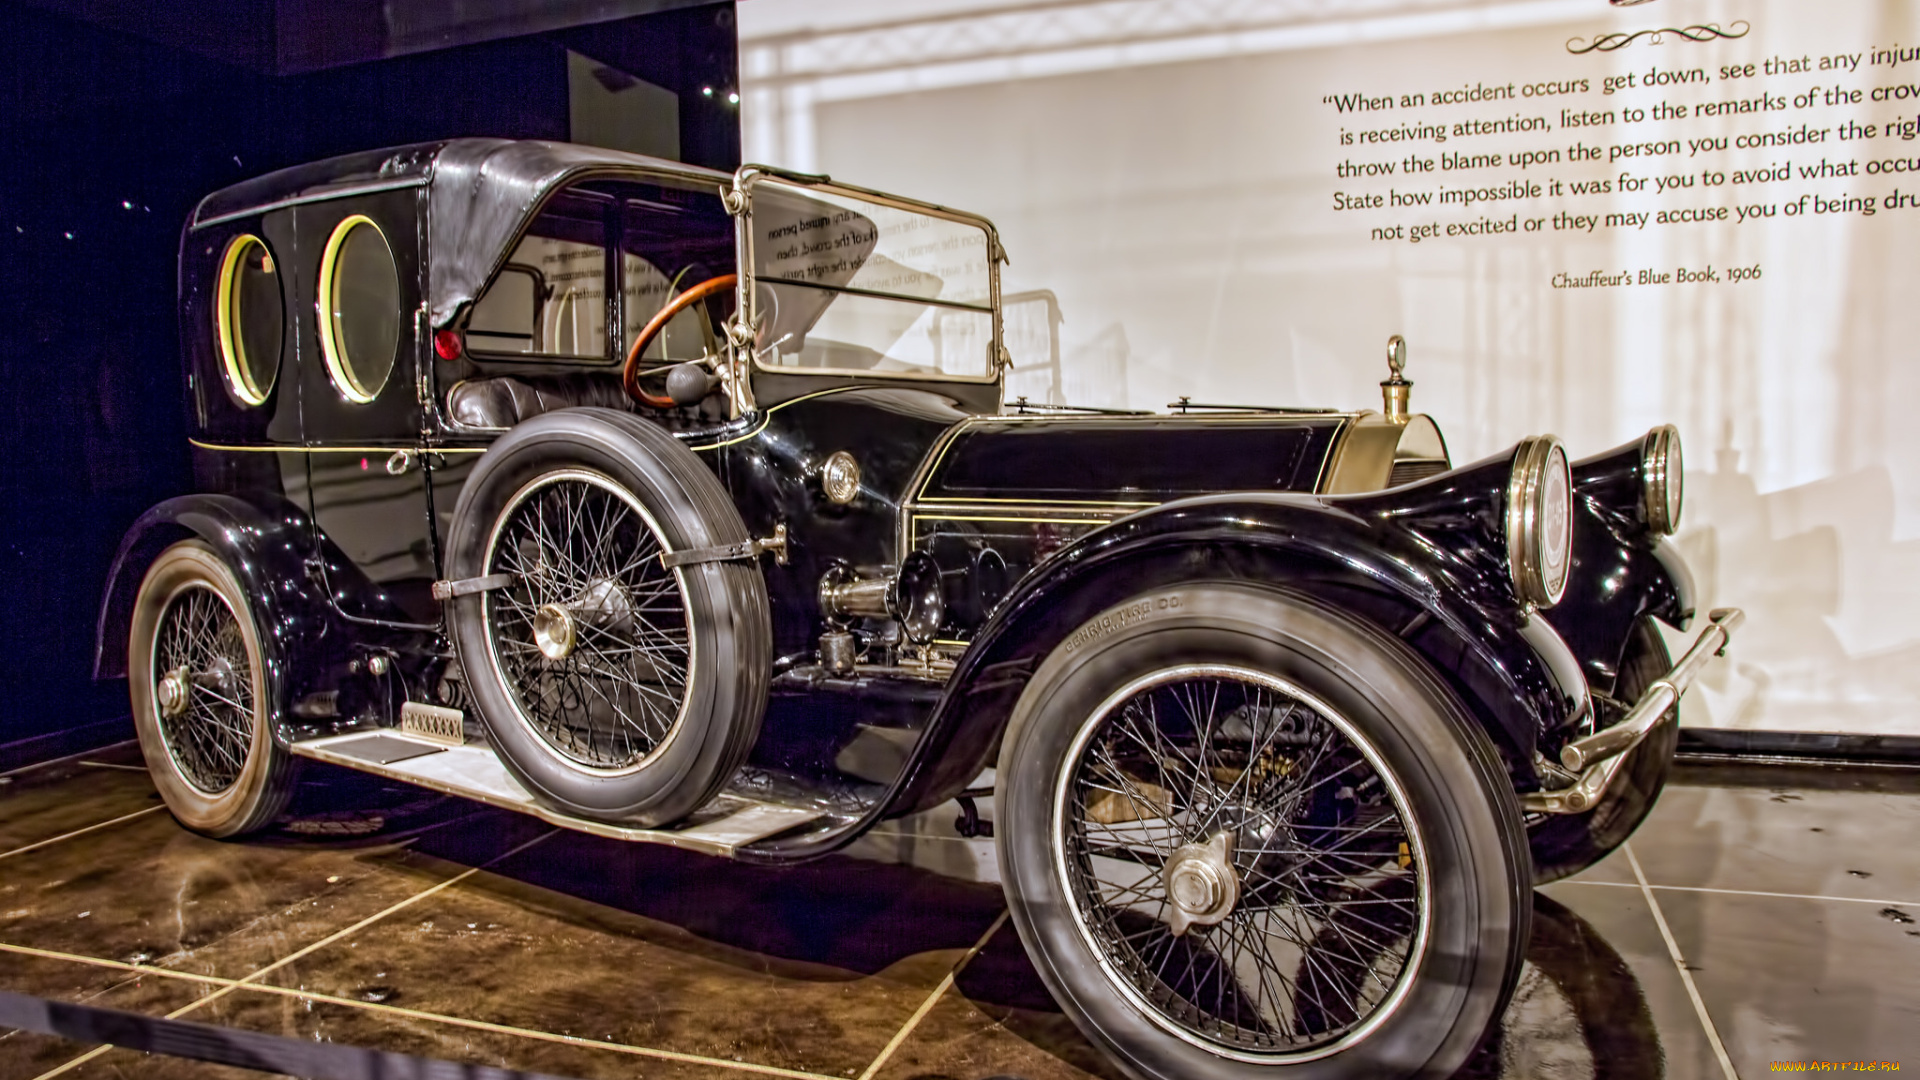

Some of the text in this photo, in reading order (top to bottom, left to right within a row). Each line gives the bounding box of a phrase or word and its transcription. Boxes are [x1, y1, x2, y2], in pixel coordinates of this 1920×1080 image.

[1401, 94, 1425, 109] an
[1431, 83, 1516, 106] accident
[1522, 79, 1590, 98] occurs
[1603, 73, 1637, 96] get
[1643, 67, 1711, 87] down,
[1720, 64, 1756, 81] see
[1764, 55, 1812, 76] that
[1819, 53, 1863, 73] any
[1341, 128, 1354, 146] is
[1360, 122, 1448, 145] receiving
[1453, 113, 1552, 137] attention,
[1561, 109, 1615, 129] listen
[1623, 107, 1646, 124] to
[1652, 101, 1688, 121] the
[1695, 91, 1787, 118] remarks
[1794, 87, 1821, 110] of
[1824, 85, 1863, 106] the
[1337, 159, 1397, 179] throw
[1402, 155, 1435, 174] the
[1442, 151, 1502, 172] blame
[1509, 150, 1561, 170] upon
[1568, 142, 1603, 162] the
[1609, 141, 1681, 164] person
[1688, 137, 1729, 158] you
[1736, 124, 1831, 150] consider
[1838, 120, 1877, 142] the
[1333, 192, 1384, 211] State
[1390, 189, 1433, 208] how
[1440, 179, 1542, 208] impossible
[1550, 178, 1564, 197] it
[1570, 180, 1612, 196] was
[1618, 172, 1649, 193] for
[1655, 175, 1695, 195] you
[1702, 170, 1726, 187] to
[1732, 161, 1791, 185] avoid
[1799, 158, 1859, 180] what
[1372, 225, 1405, 241] not
[1410, 222, 1441, 244] get
[1447, 214, 1517, 237] excited
[1524, 219, 1546, 233] or
[1552, 211, 1599, 234] they
[1605, 212, 1650, 230] may
[1656, 207, 1729, 225] accuse
[1736, 204, 1777, 225] you
[1784, 195, 1811, 217] of
[1815, 193, 1877, 217] being
[1638, 268, 1671, 286] Blue
[1677, 265, 1721, 284] Book,
[1727, 264, 1762, 284] 1906
